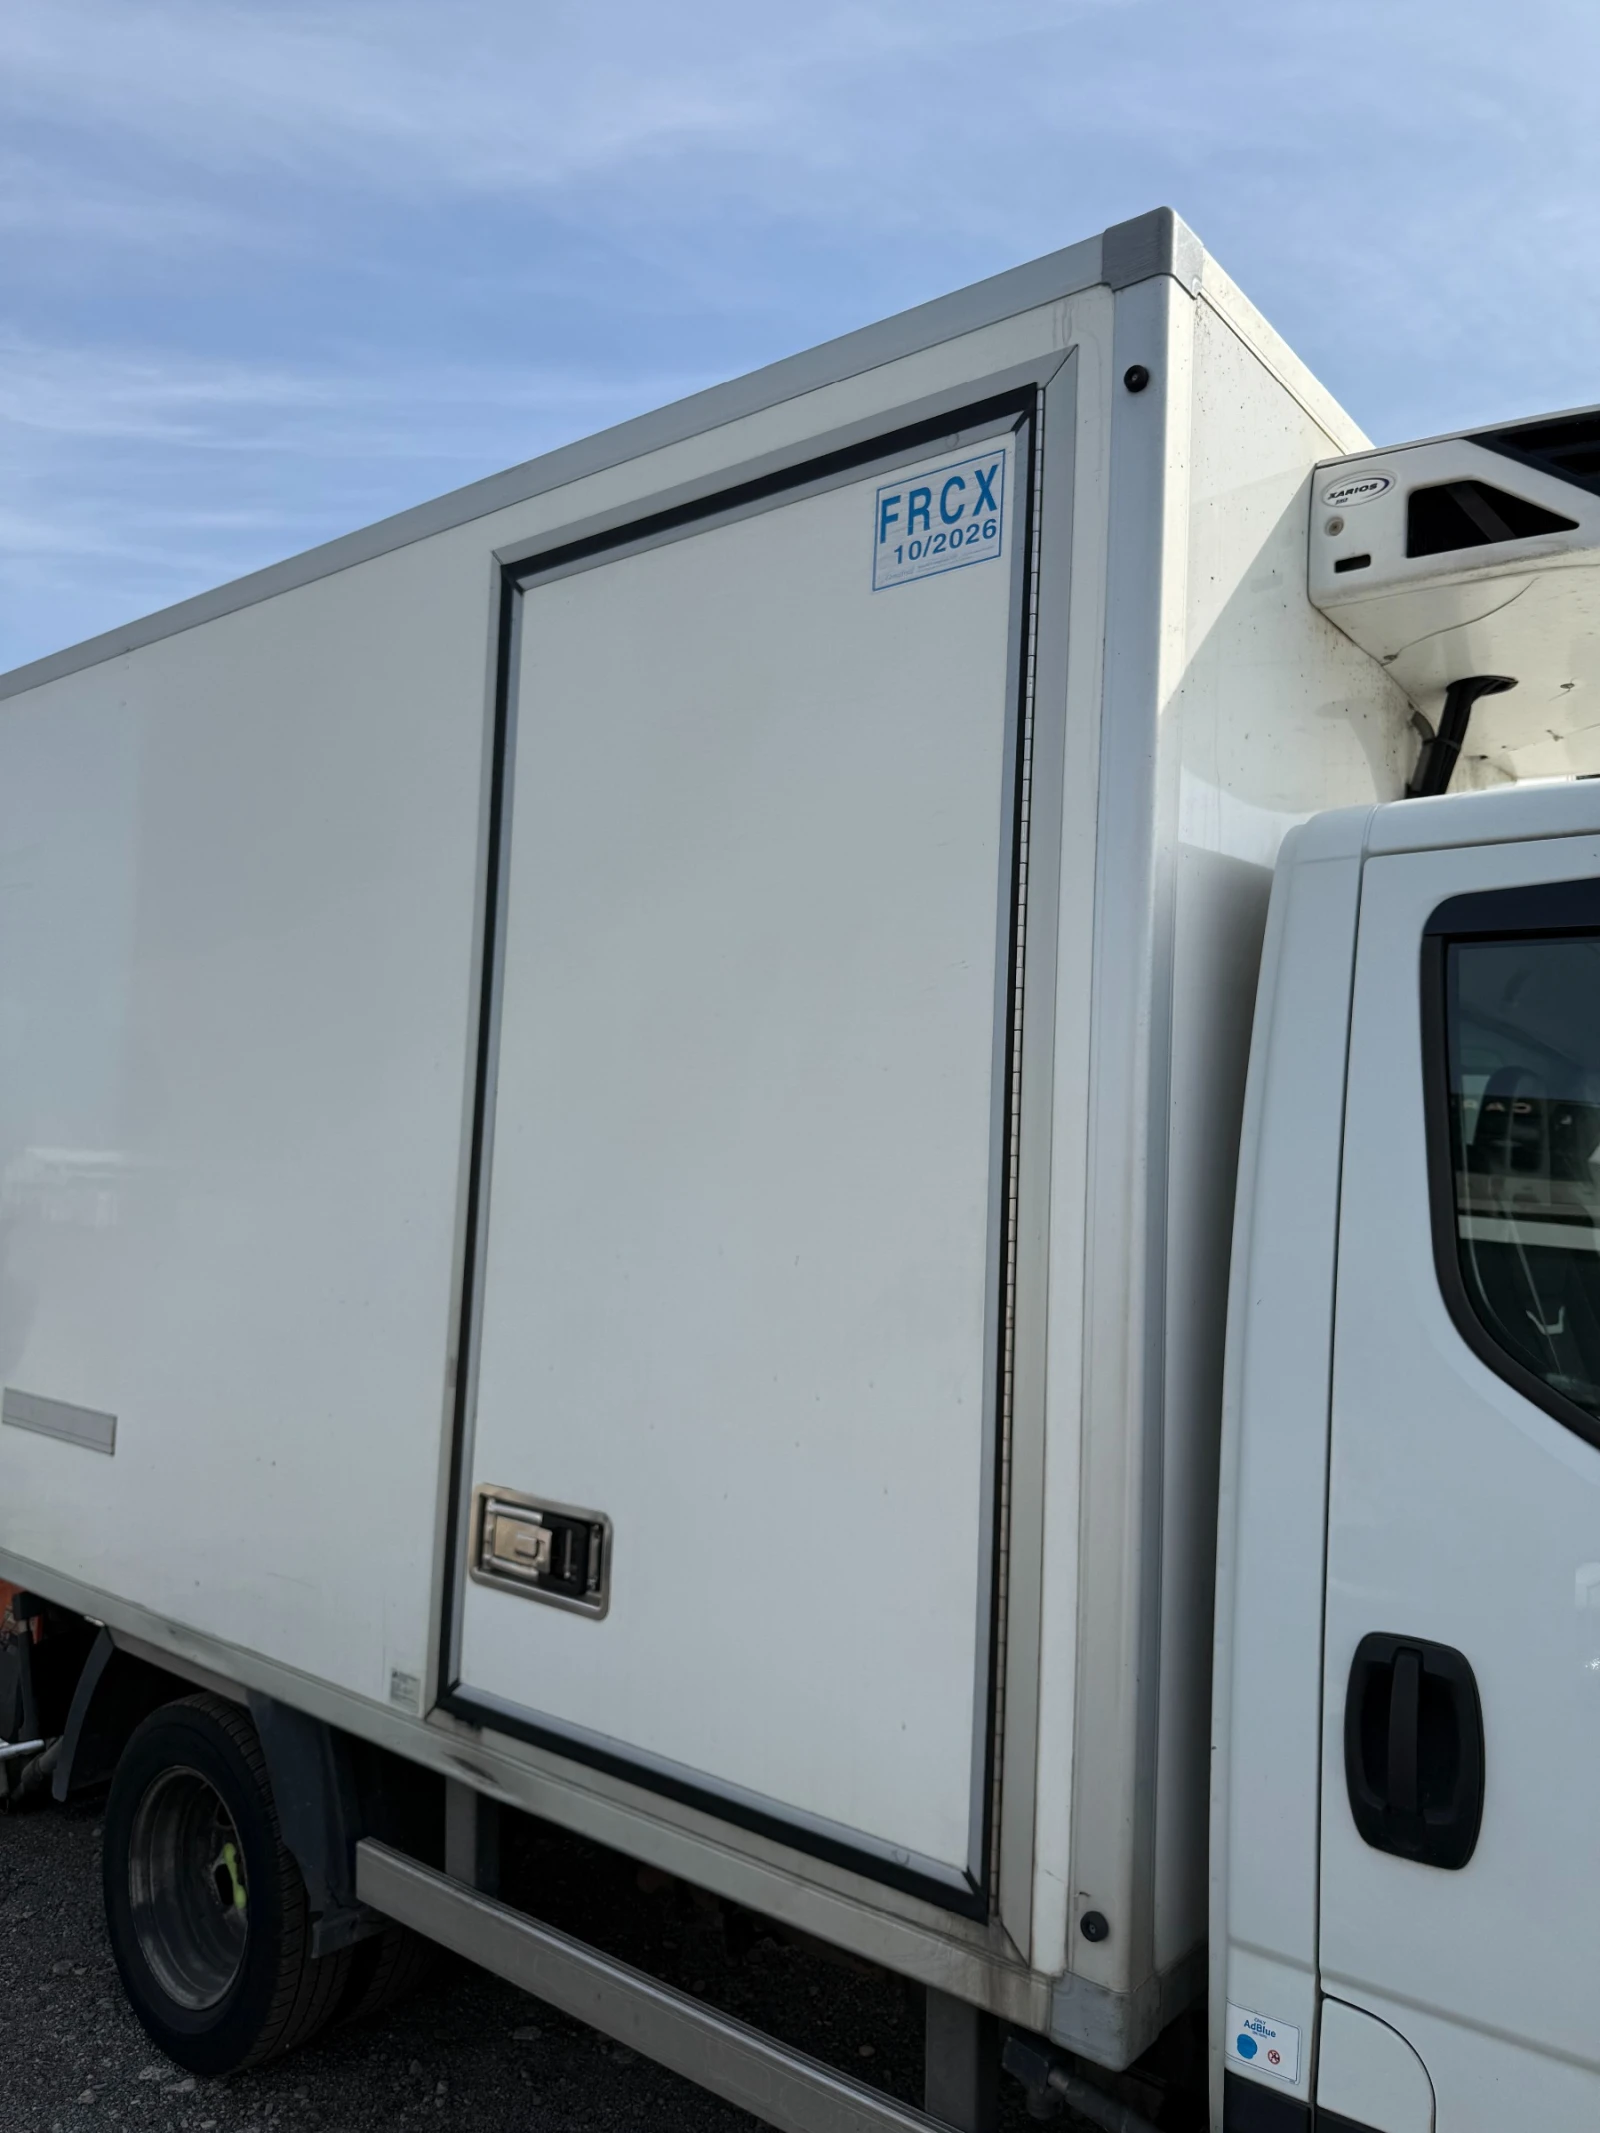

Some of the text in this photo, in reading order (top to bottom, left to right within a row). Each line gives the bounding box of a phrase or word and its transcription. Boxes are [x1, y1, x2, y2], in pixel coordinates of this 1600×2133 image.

[879, 463, 999, 544] FRCX
[1327, 482, 1378, 500] XARIOS
[893, 518, 997, 565] 10/2026
[1243, 2019, 1277, 2038] AdBlue
